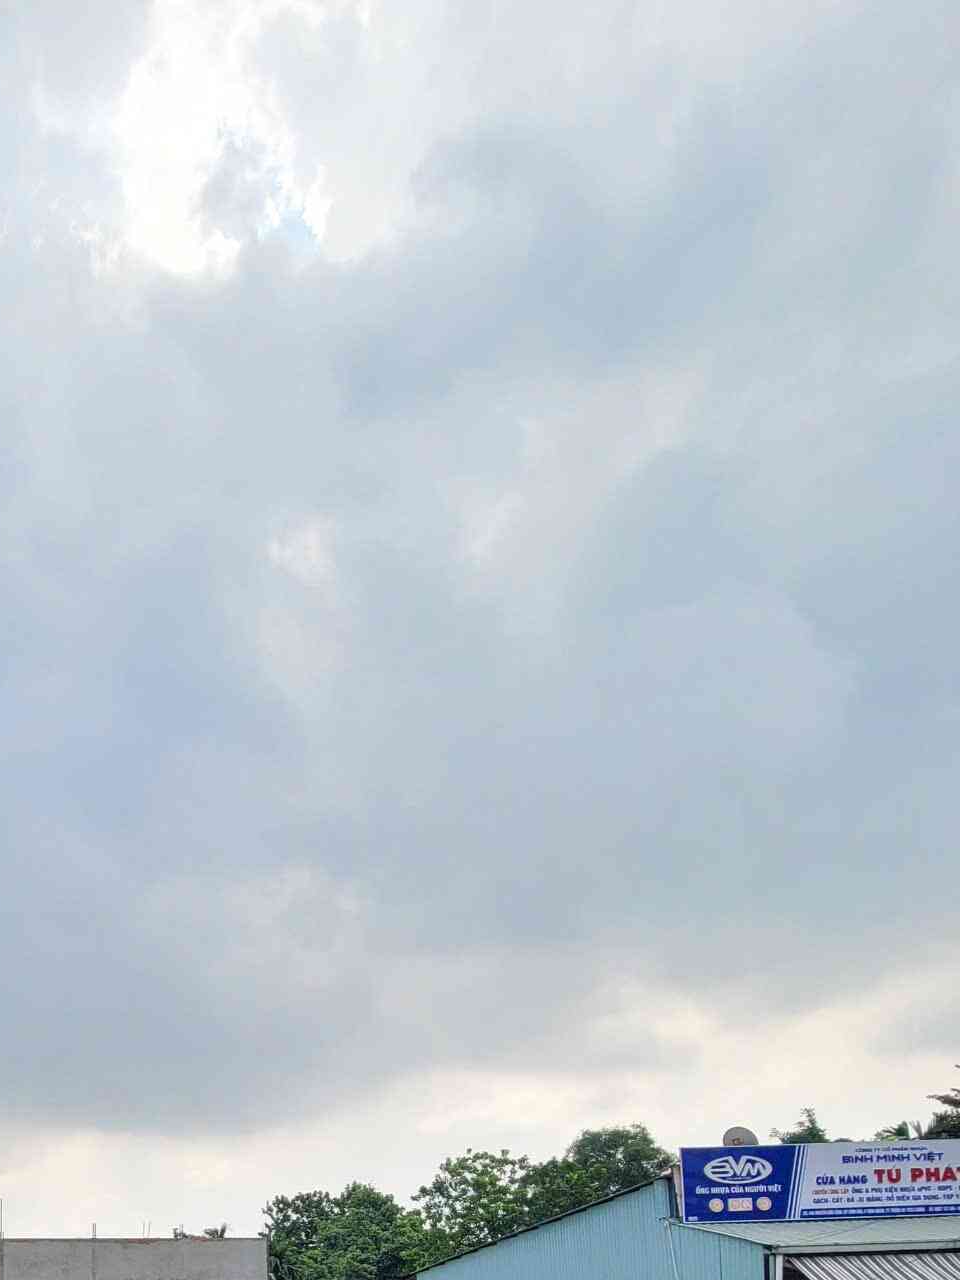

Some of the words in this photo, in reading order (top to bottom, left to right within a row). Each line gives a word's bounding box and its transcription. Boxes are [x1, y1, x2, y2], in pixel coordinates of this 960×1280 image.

[876, 1153, 910, 1163] MINH
[913, 1151, 944, 1163] VIỆT
[839, 1174, 868, 1185] HÀNG
